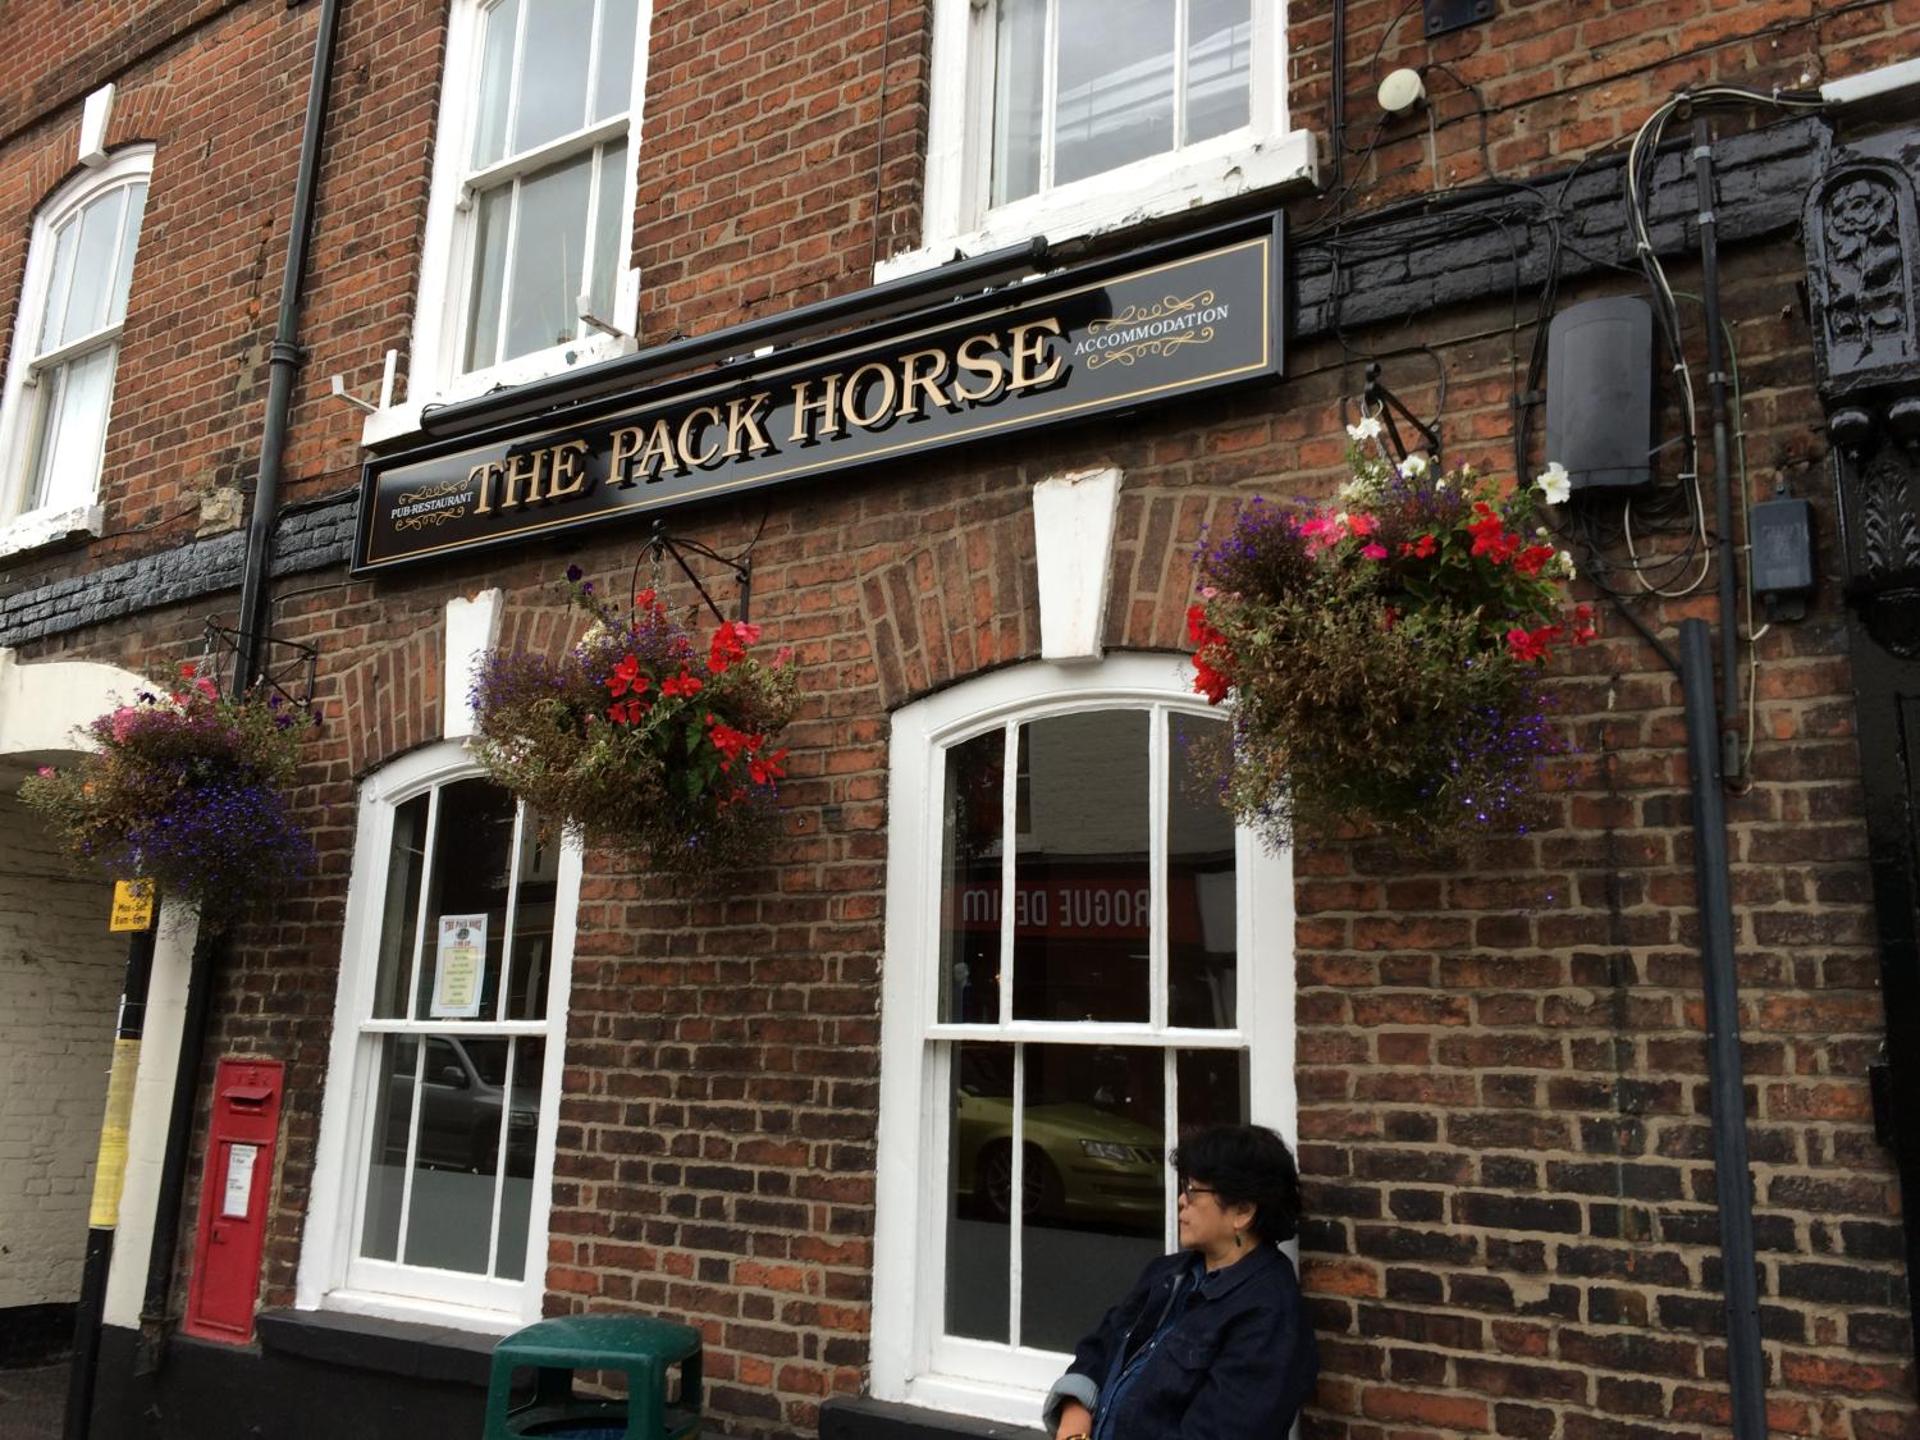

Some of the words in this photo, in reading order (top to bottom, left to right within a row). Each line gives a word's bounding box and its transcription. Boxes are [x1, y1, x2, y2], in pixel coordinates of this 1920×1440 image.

[1074, 304, 1229, 355] ACCOMMODATION
[467, 439, 589, 515] THE
[606, 391, 772, 486] PACK
[788, 317, 1063, 442] HORSE
